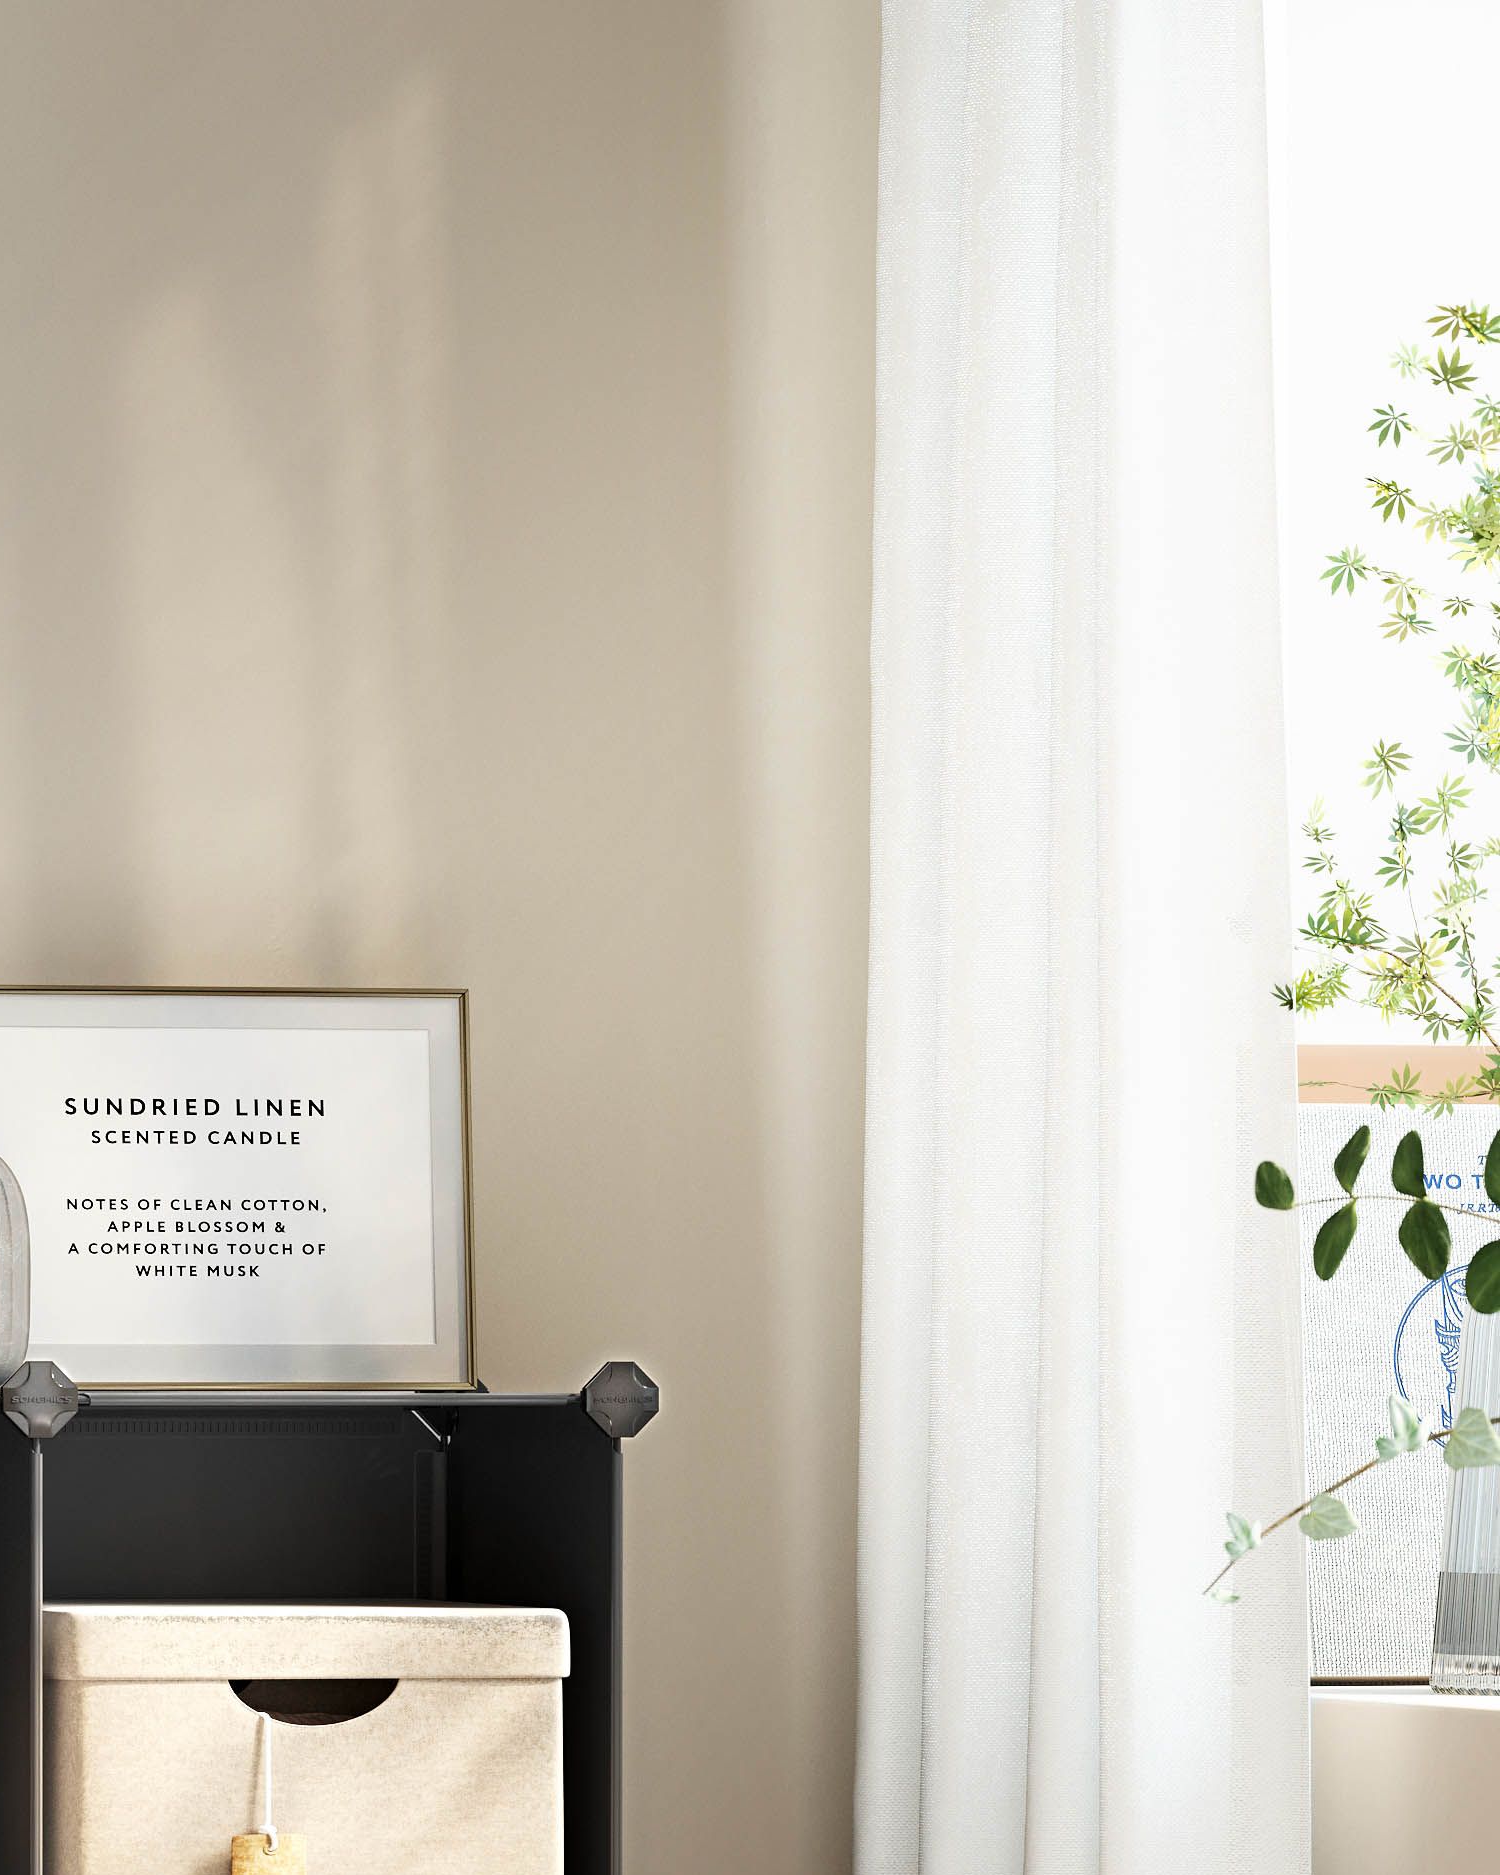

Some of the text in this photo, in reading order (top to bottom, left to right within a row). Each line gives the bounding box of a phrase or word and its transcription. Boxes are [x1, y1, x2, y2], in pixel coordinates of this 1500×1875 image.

[64, 1097, 325, 1117] SUNDRIED LINEN
[91, 1130, 301, 1145] SCENTED CANDLE
[66, 1198, 327, 1213] NOTES OF CLEAN COTTON,
[107, 1220, 286, 1233] APPLE BLOSSOM &
[67, 1242, 326, 1256] A COMFORTING TOUCH OF
[135, 1265, 260, 1277] WHITE MUSK
